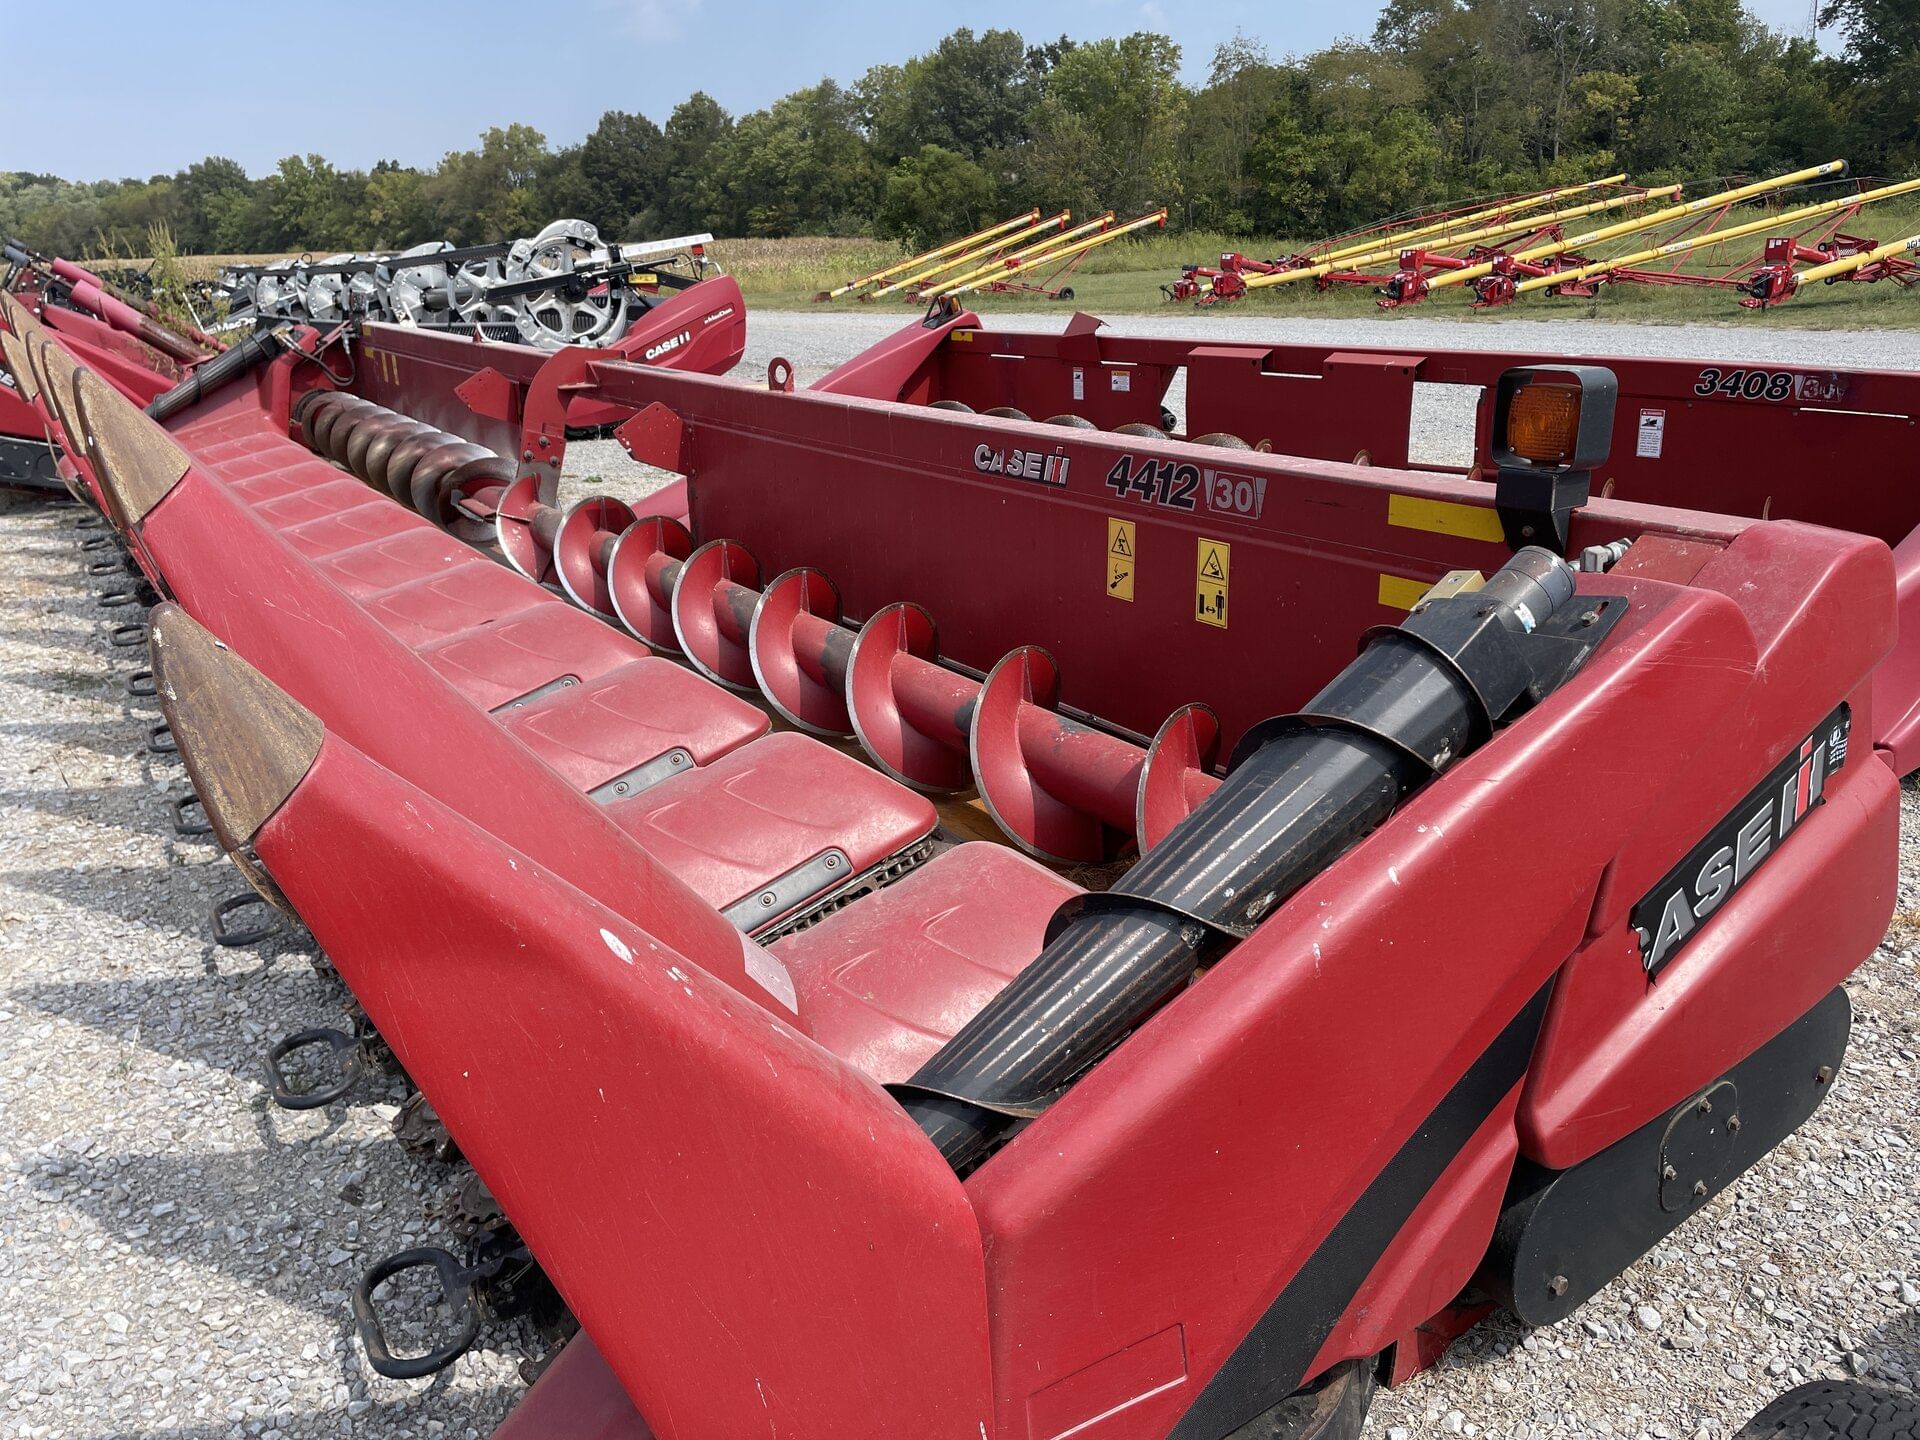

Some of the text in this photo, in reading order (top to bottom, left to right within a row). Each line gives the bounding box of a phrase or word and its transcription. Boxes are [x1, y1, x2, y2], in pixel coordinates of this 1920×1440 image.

[222, 317, 258, 332] MacDo
[645, 336, 679, 360] CASE
[1694, 368, 1793, 401] 3408
[973, 443, 1044, 482] CASE
[1105, 454, 1254, 514] 4412 30
